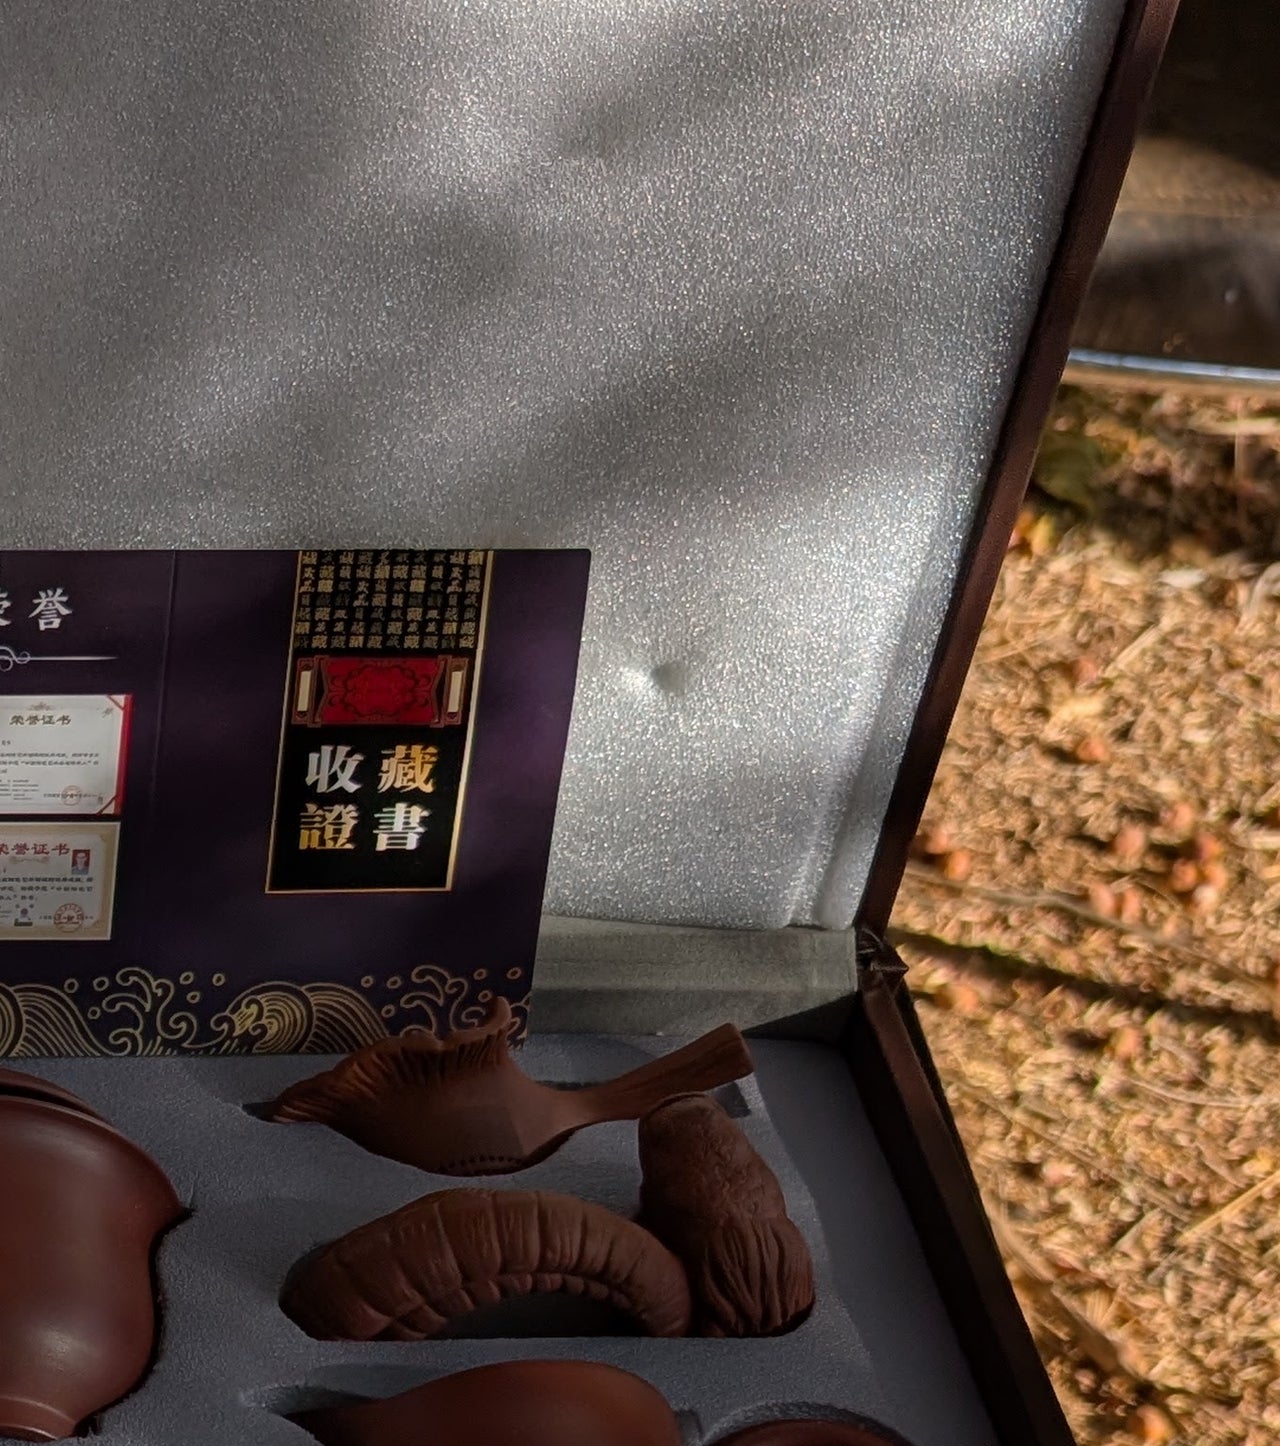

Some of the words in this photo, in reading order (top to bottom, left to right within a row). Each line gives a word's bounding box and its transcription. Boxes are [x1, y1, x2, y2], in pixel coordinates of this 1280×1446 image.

[9, 714, 72, 726] 荣誉证书
[305, 744, 439, 794] 收藏
[298, 801, 432, 853] 證書
